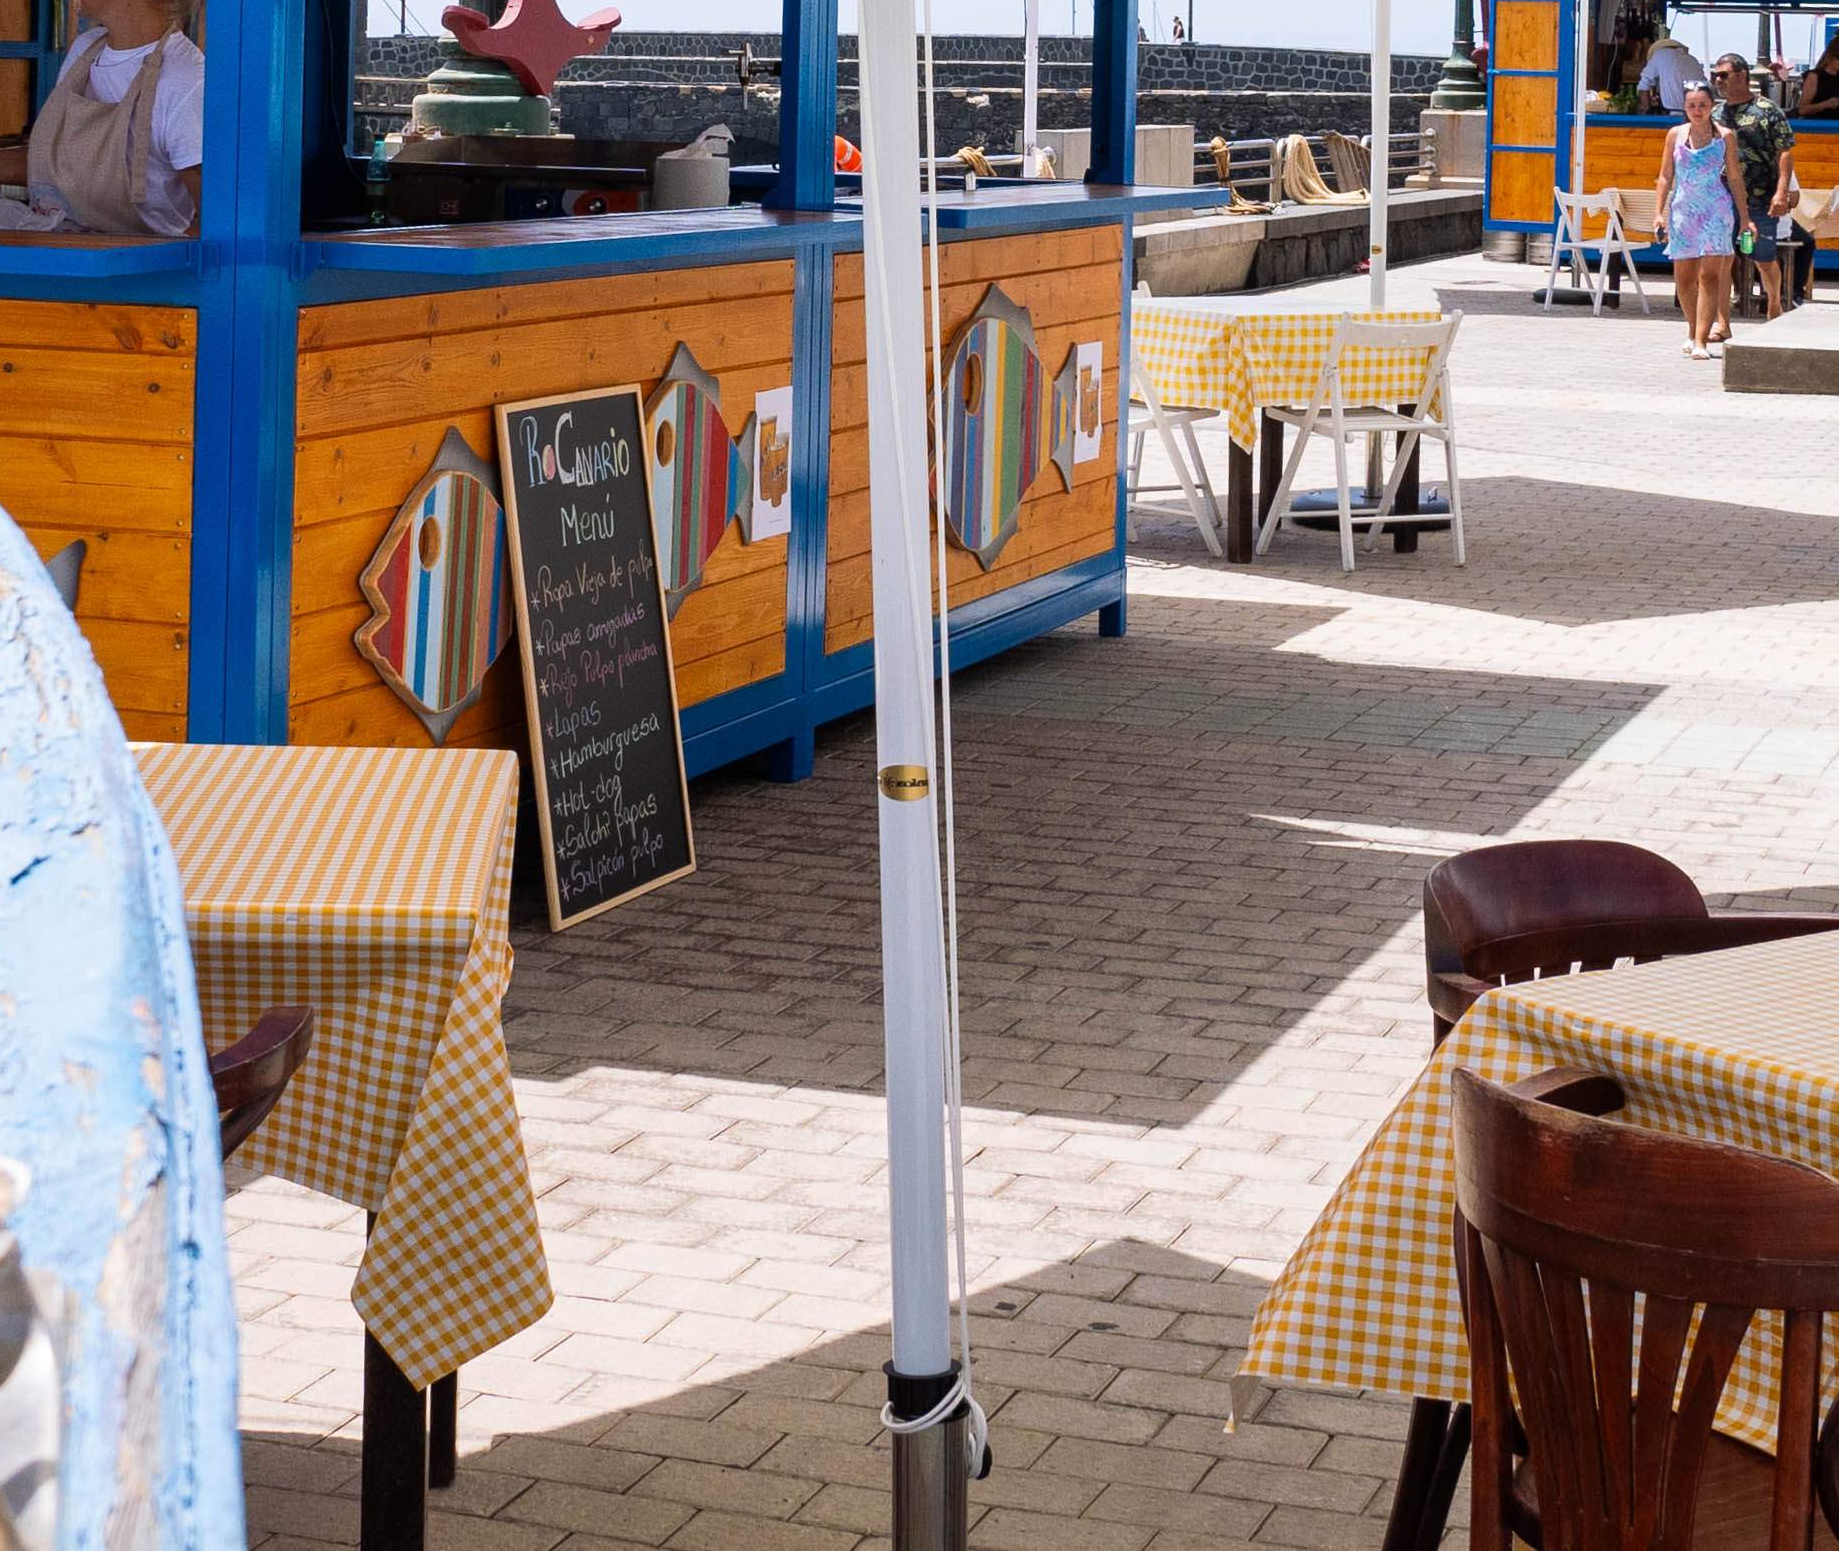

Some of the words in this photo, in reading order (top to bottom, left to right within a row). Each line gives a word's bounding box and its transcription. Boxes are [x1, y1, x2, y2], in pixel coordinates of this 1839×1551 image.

[561, 493, 615, 547] Menú
[609, 554, 624, 588] de
[554, 700, 602, 744] Lapas
[560, 712, 660, 778] Hamburguesa
